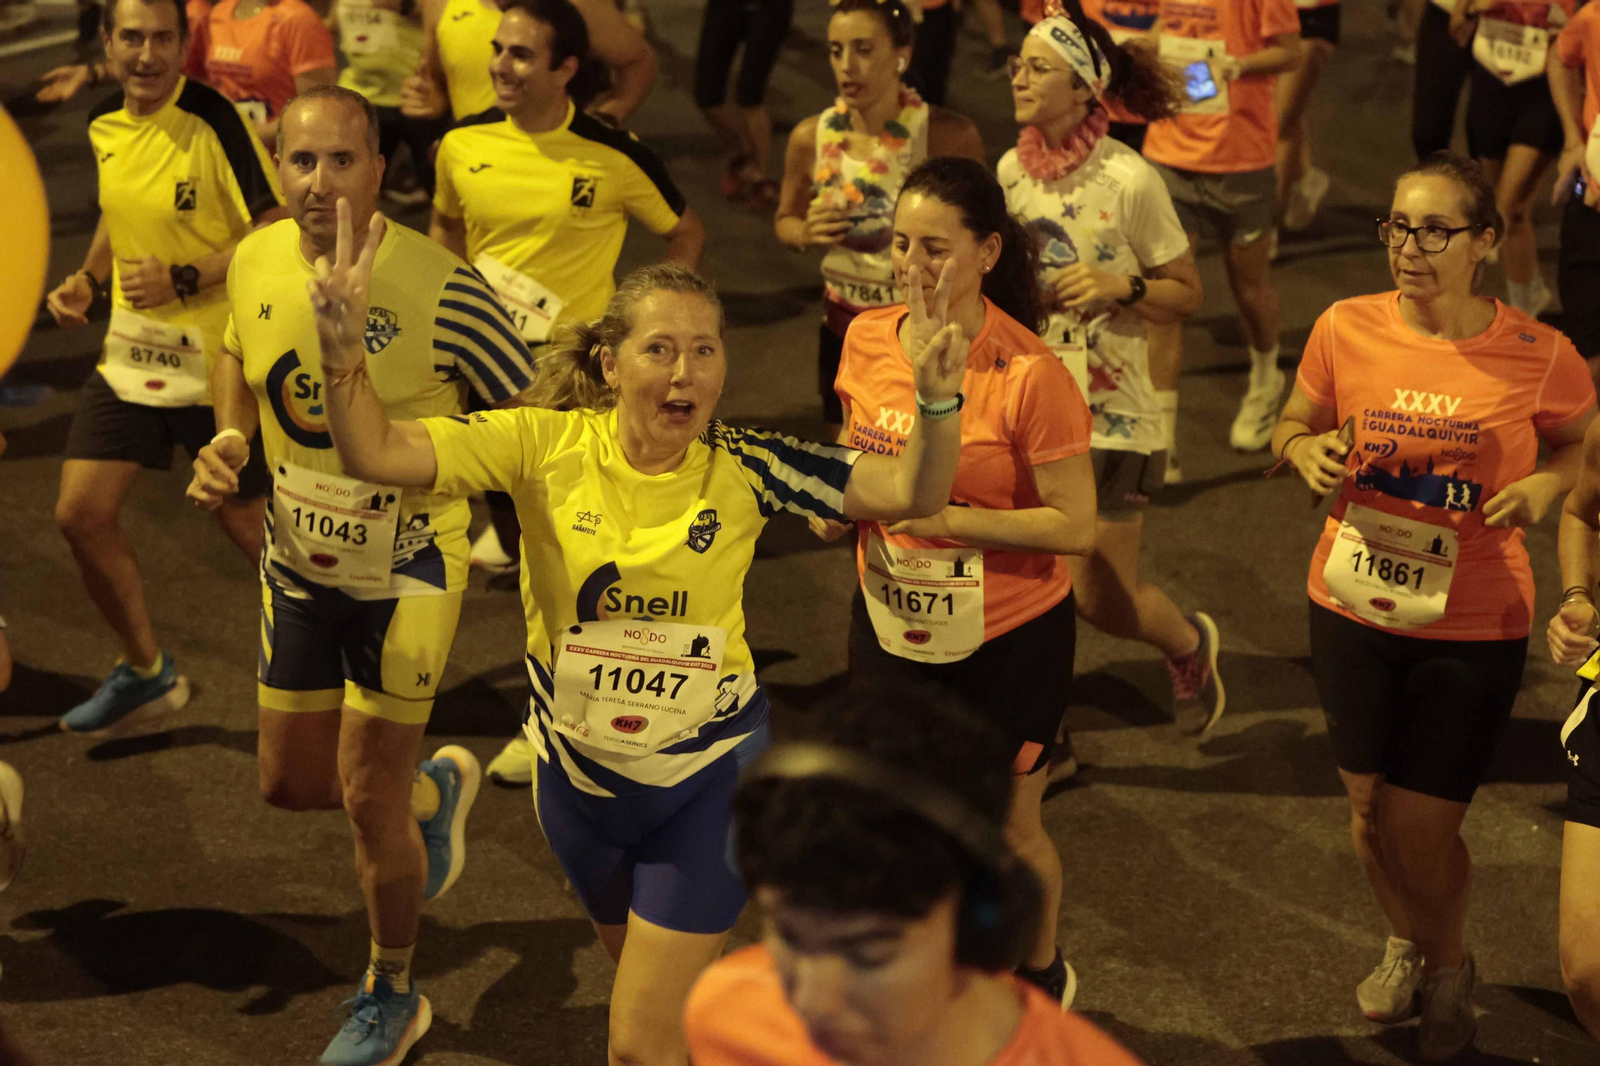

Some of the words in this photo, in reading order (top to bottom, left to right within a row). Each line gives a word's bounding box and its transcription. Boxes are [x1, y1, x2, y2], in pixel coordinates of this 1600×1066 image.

[130, 346, 181, 369] 8740
[1391, 388, 1462, 417] XXXV
[1364, 408, 1412, 423] CARRERA
[1417, 416, 1480, 432] NOCTURNA
[853, 421, 892, 444] CARRERA
[1368, 420, 1479, 445] GUADALQUIVIR
[1363, 442, 1391, 456] KH7
[292, 507, 368, 545] 11043
[1352, 551, 1425, 590] 11861
[604, 587, 688, 617] Snell
[881, 583, 953, 615] 11671
[569, 645, 585, 653] XXXV
[585, 647, 609, 657] CARRERA
[610, 651, 639, 661] NOCTURNA
[650, 657, 690, 667] GUADALQUIVIR
[589, 664, 688, 700] 11047
[580, 691, 600, 702] MARIA
[601, 696, 626, 706] TERESA
[627, 700, 660, 711] SERRANO
[660, 705, 687, 715] LUCENA
[614, 718, 642, 732] KH7
